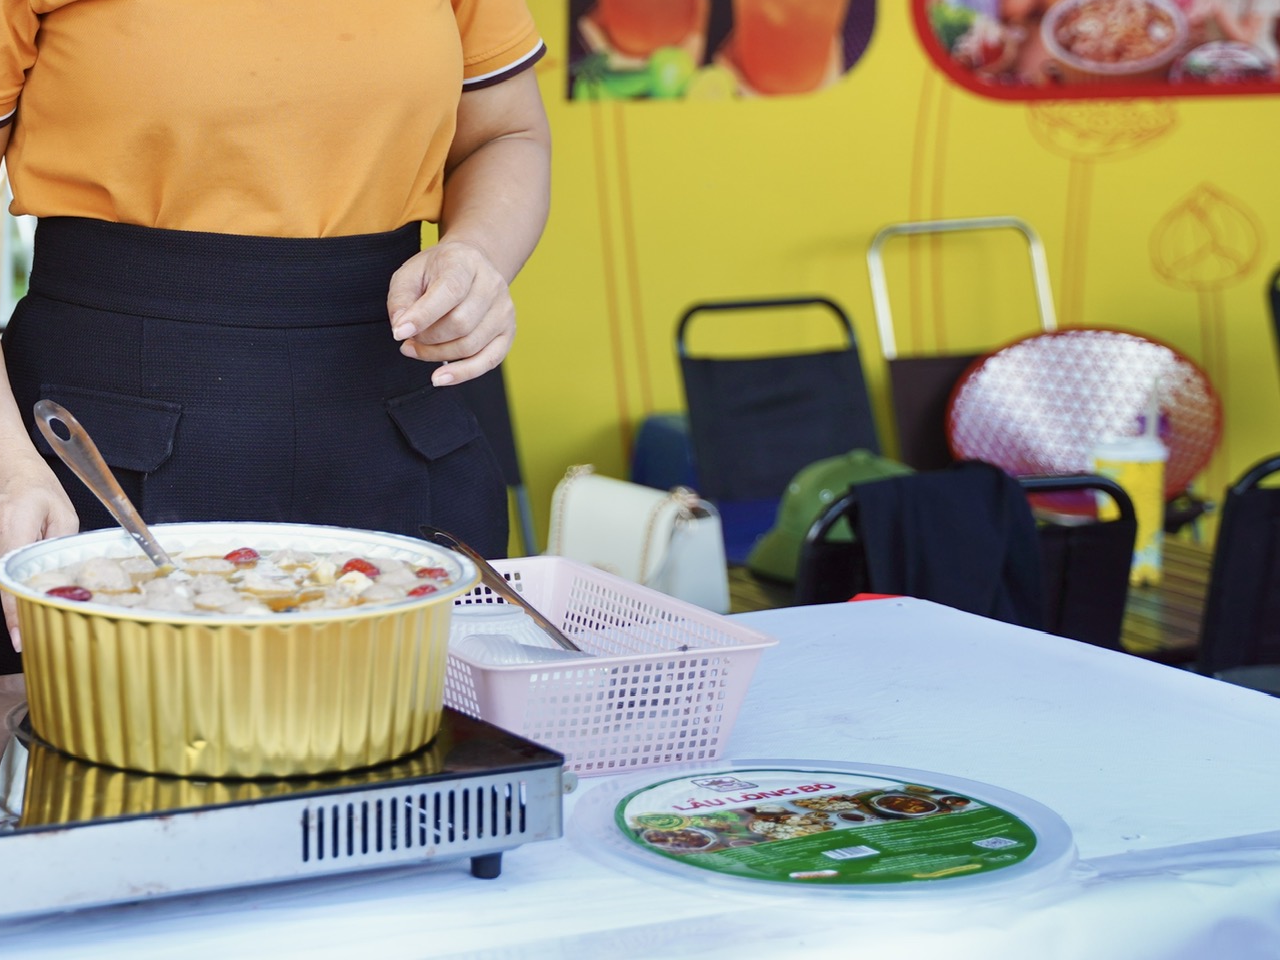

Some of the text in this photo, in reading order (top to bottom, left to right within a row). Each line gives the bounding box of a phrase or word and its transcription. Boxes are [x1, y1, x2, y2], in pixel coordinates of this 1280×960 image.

[672, 782, 837, 811] LẨU LÒNG BÒ
